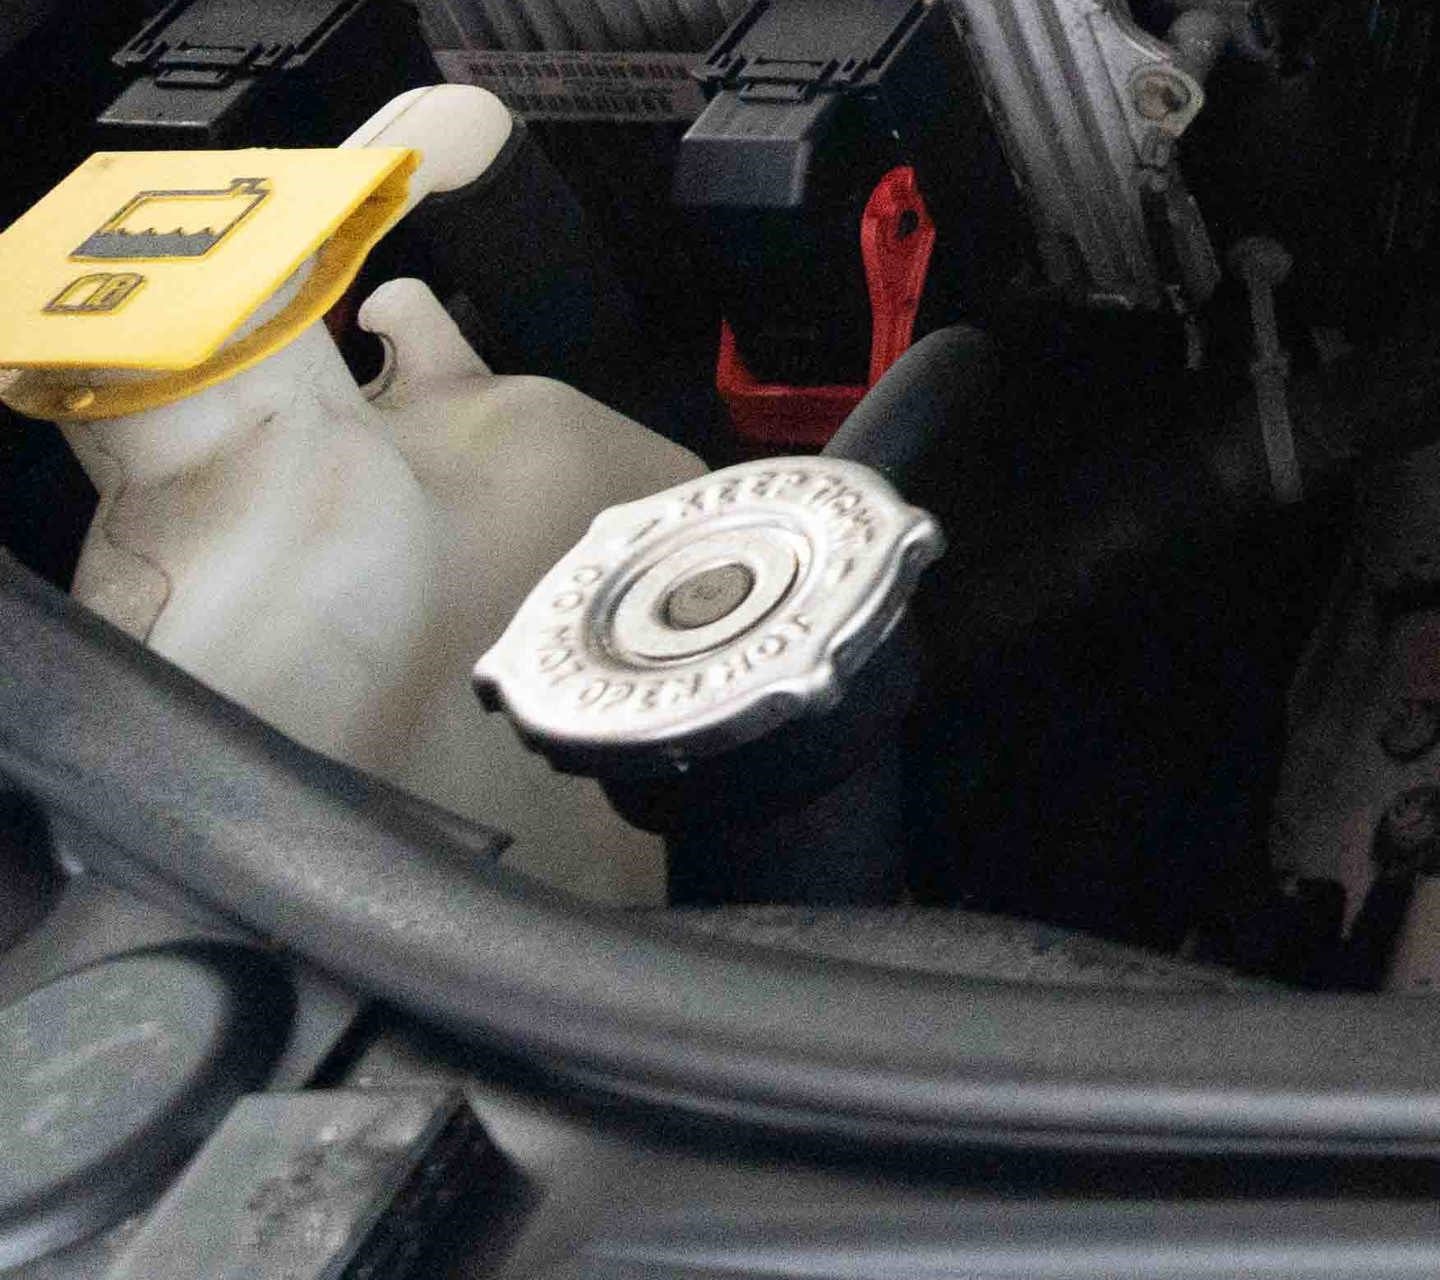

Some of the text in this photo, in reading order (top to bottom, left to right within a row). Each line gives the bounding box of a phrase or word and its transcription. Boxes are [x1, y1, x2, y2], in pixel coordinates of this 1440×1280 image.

[680, 470, 809, 517] KEEP
[554, 566, 602, 610] DO
[726, 614, 812, 682] HOT
[577, 670, 705, 712] OPEN
